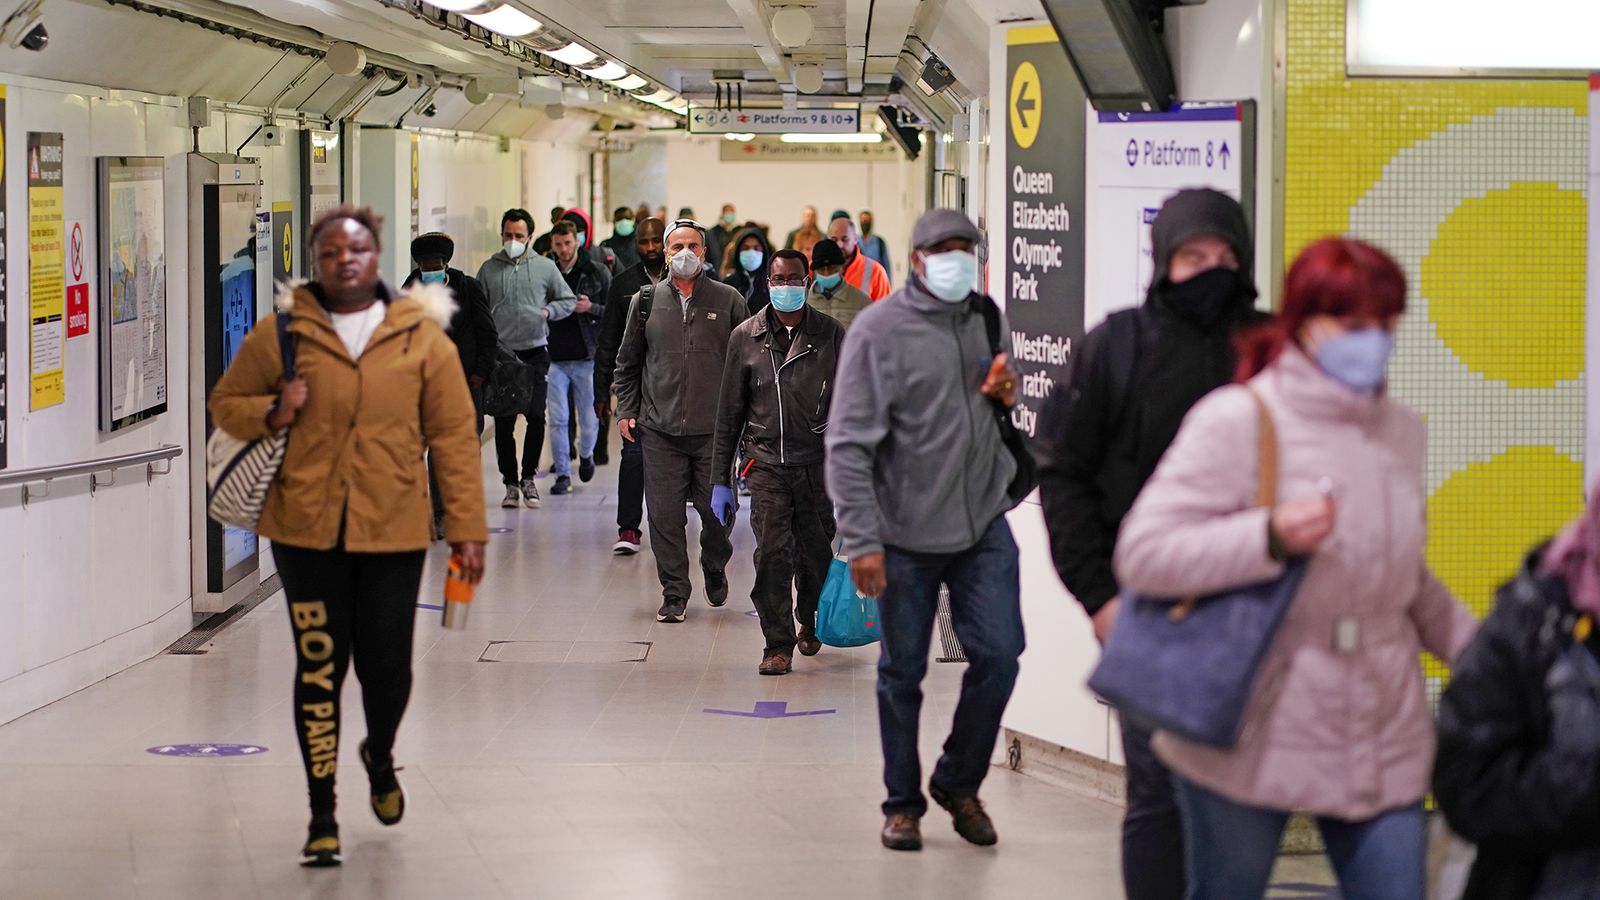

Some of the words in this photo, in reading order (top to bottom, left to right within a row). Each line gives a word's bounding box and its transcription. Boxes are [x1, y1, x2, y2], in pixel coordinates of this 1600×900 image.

[753, 114, 808, 125] Platforms
[811, 115, 819, 124] 9
[820, 115, 828, 124] &
[831, 115, 843, 124] 10
[1143, 139, 1201, 167] Platform
[1205, 140, 1214, 168] 8
[1012, 164, 1054, 195] Queen
[1012, 200, 1070, 232] Elizabeth
[1012, 236, 1063, 274] Olympic
[1012, 271, 1039, 301] Park
[69, 311, 87, 329] smoking
[292, 600, 335, 691] BOY
[302, 701, 337, 779] PARIS
